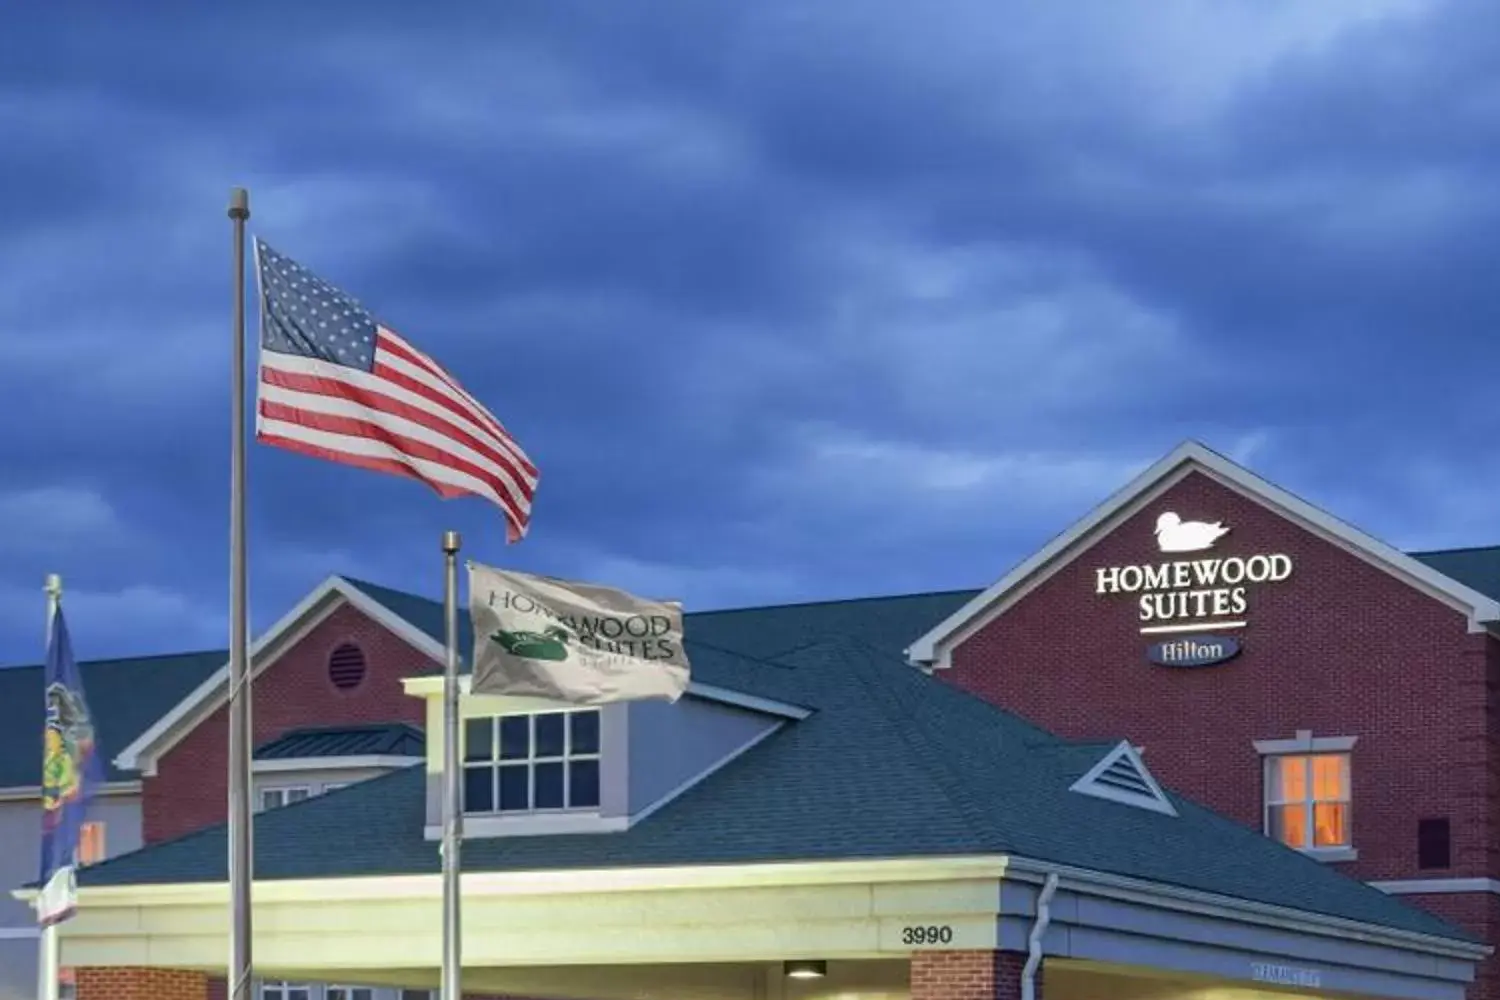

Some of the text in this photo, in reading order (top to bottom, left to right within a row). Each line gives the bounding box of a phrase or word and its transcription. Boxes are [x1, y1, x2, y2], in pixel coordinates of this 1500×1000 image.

[1095, 554, 1292, 593] HOMEWOOD
[489, 590, 671, 638] HOWOOD
[1139, 588, 1247, 620] SUITES
[1162, 640, 1223, 661] Hilton
[902, 926, 953, 944] 3990
